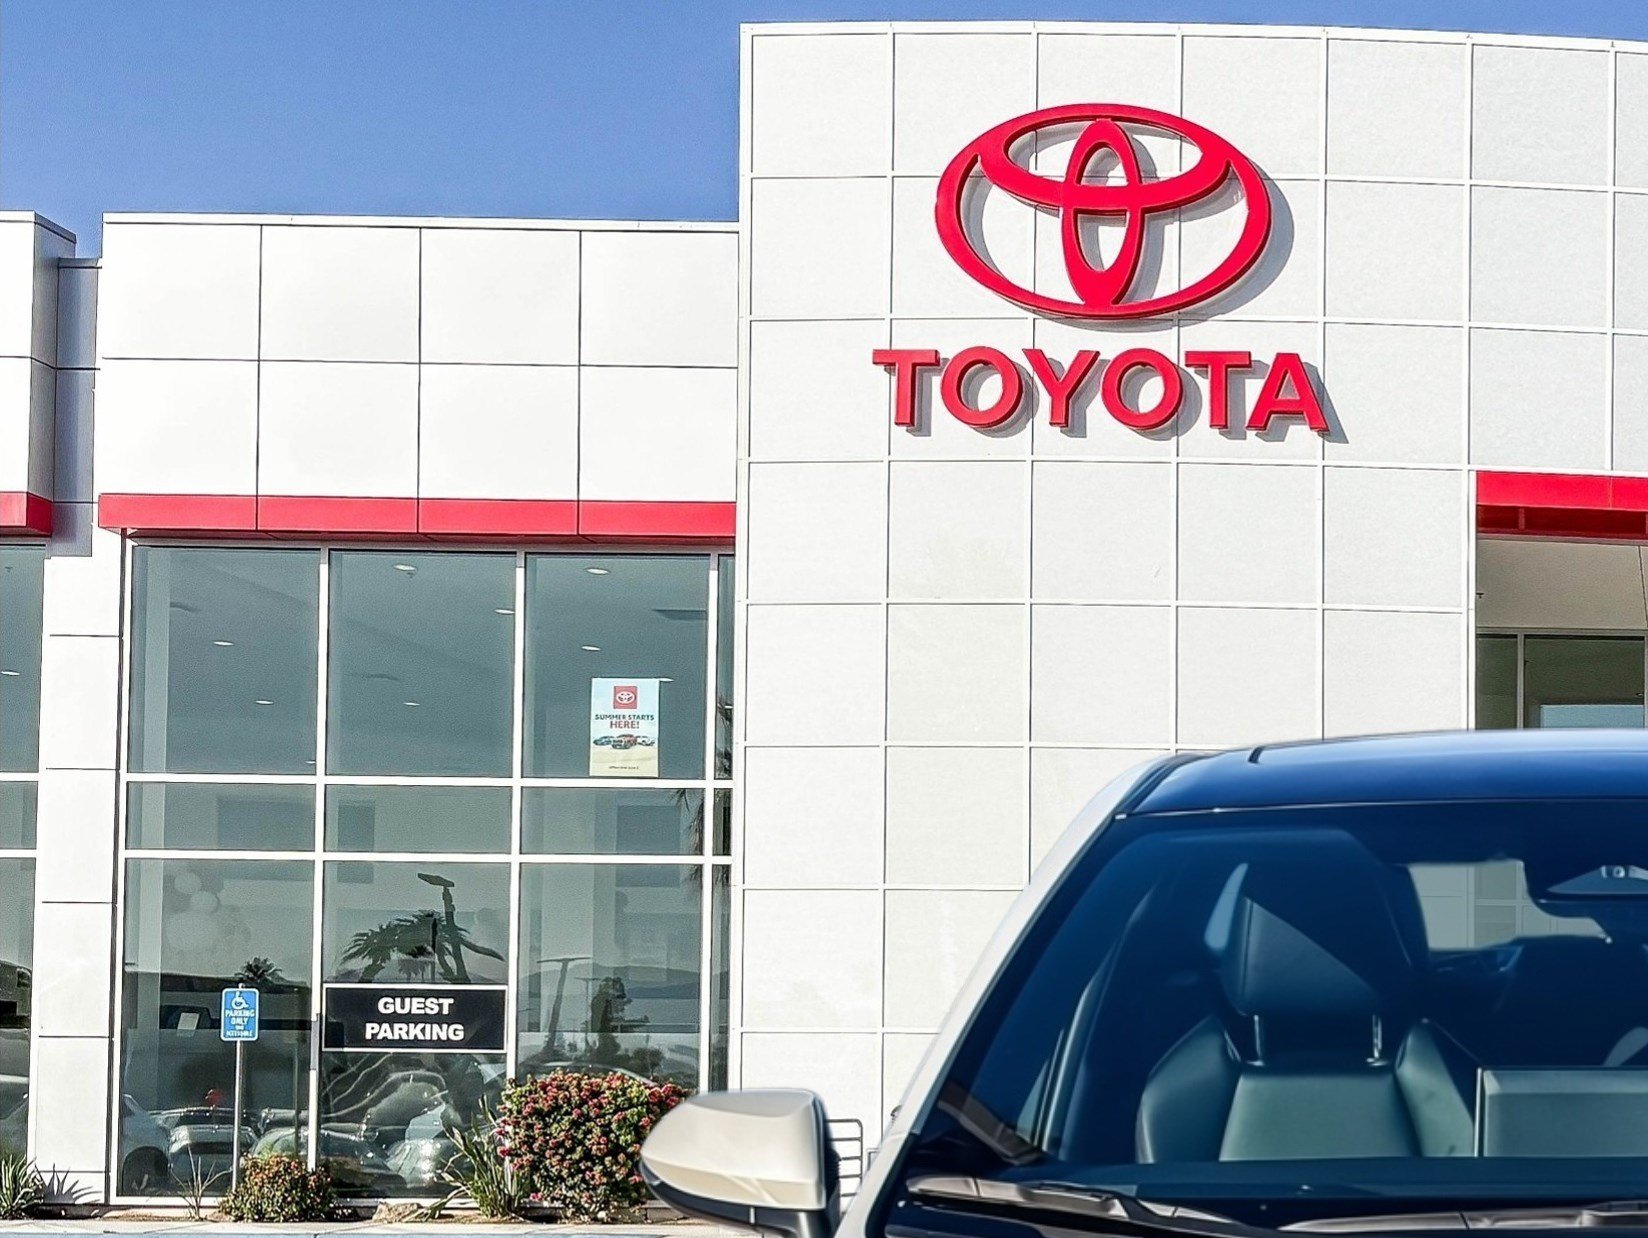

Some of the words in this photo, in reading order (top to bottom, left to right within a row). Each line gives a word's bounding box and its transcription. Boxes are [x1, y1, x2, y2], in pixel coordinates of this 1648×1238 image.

[872, 346, 1329, 433] TOYOTA
[609, 720, 640, 729] HERE!
[377, 997, 454, 1015] GUEST
[365, 1022, 465, 1041] PARKING
